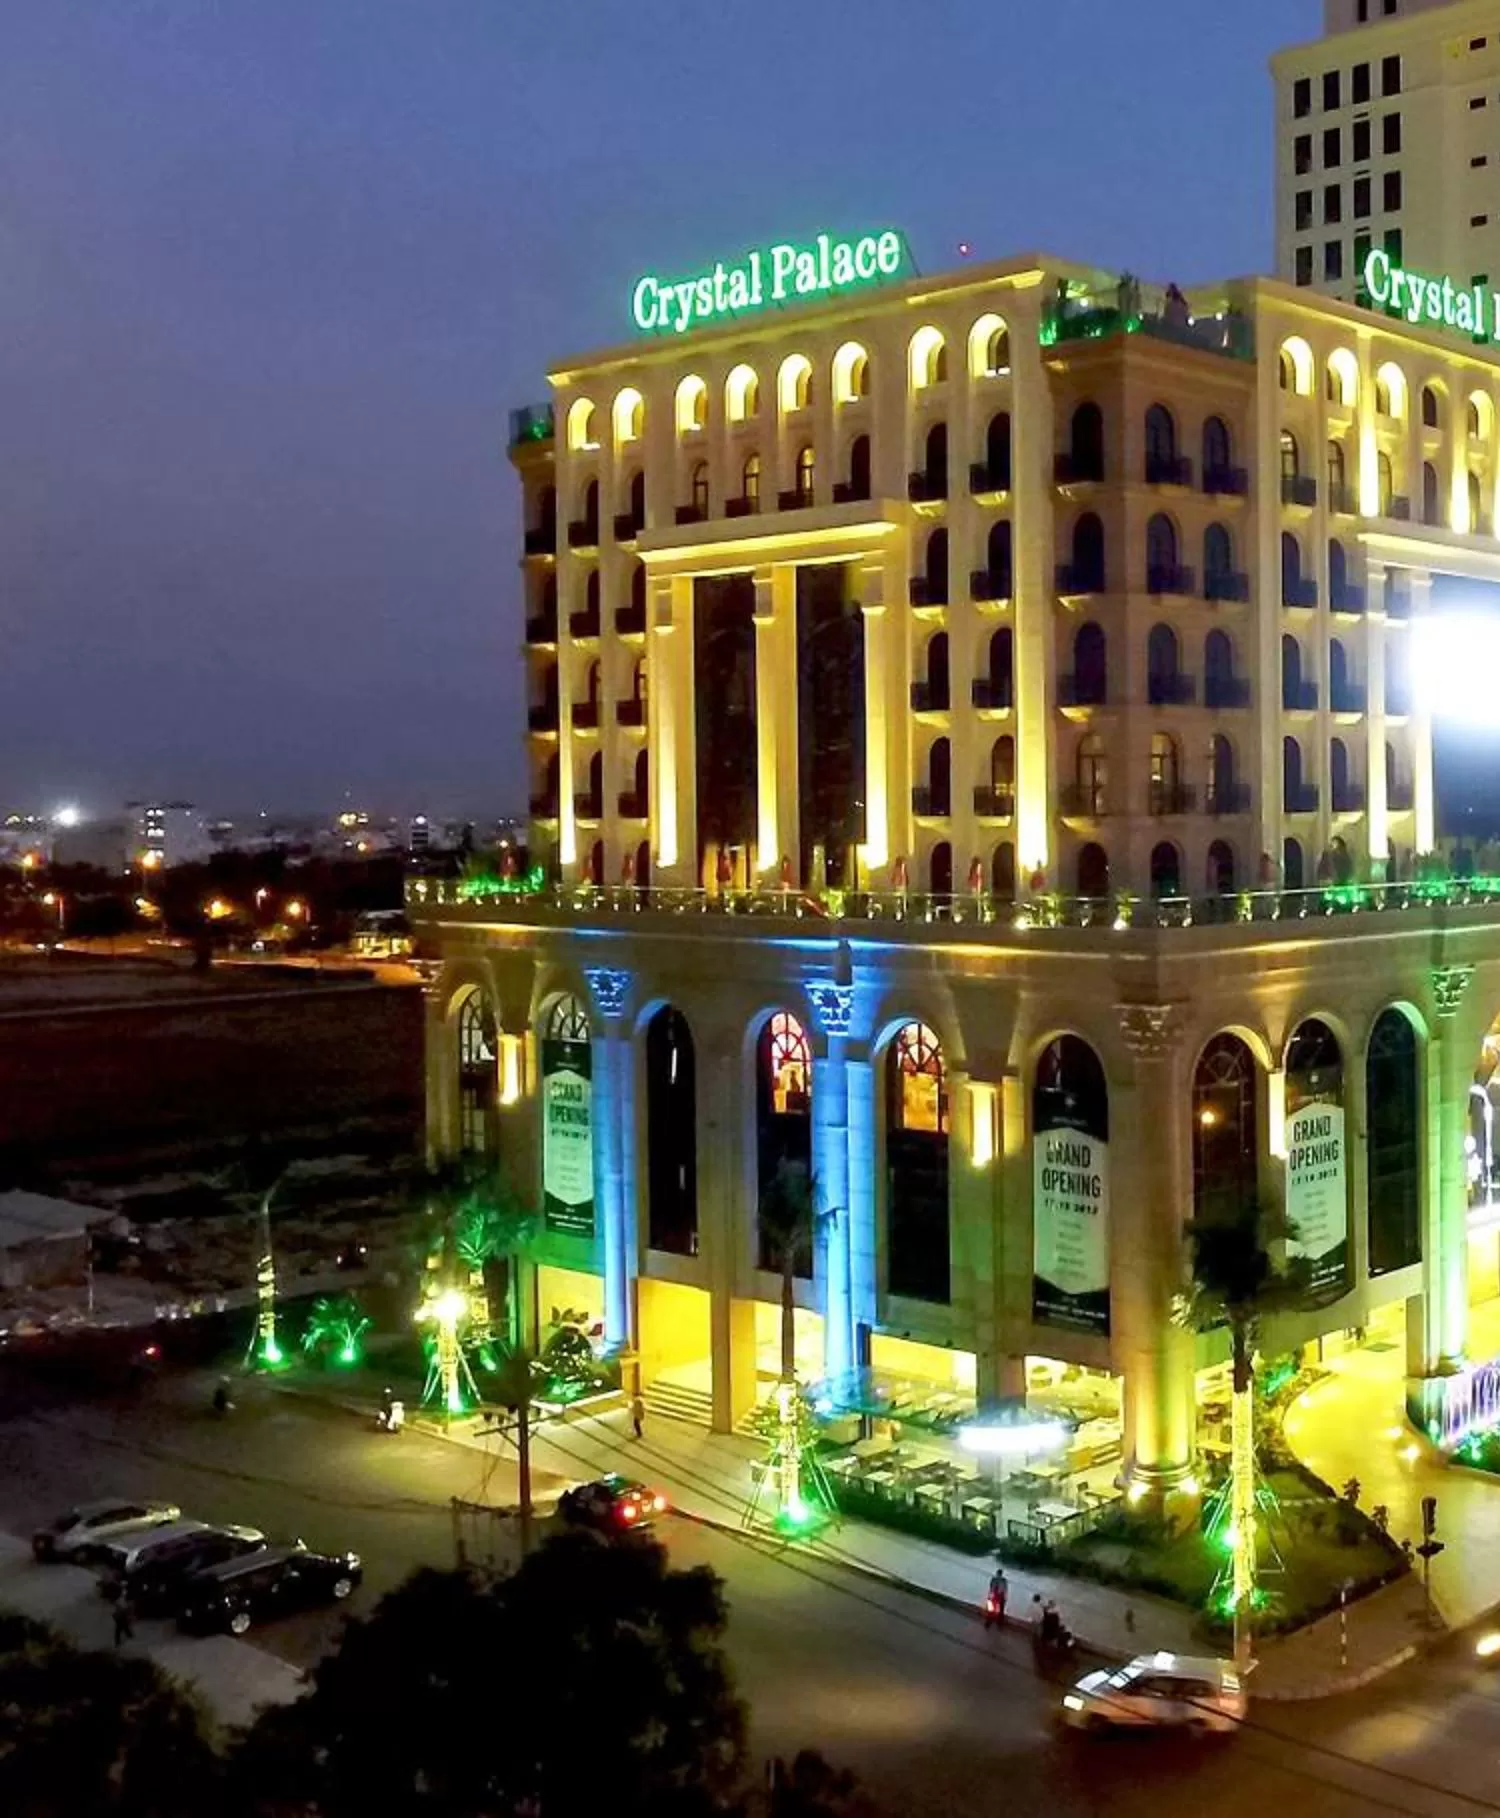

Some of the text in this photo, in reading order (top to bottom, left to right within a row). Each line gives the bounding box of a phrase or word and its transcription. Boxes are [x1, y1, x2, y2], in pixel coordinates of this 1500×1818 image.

[632, 230, 901, 334] Crystal Palace
[1363, 249, 1486, 336] Crystal
[1293, 1115, 1332, 1143] GRAND
[1045, 1138, 1092, 1170] GRAND
[1289, 1139, 1340, 1172] OPENING
[1041, 1165, 1102, 1199] OPENING
